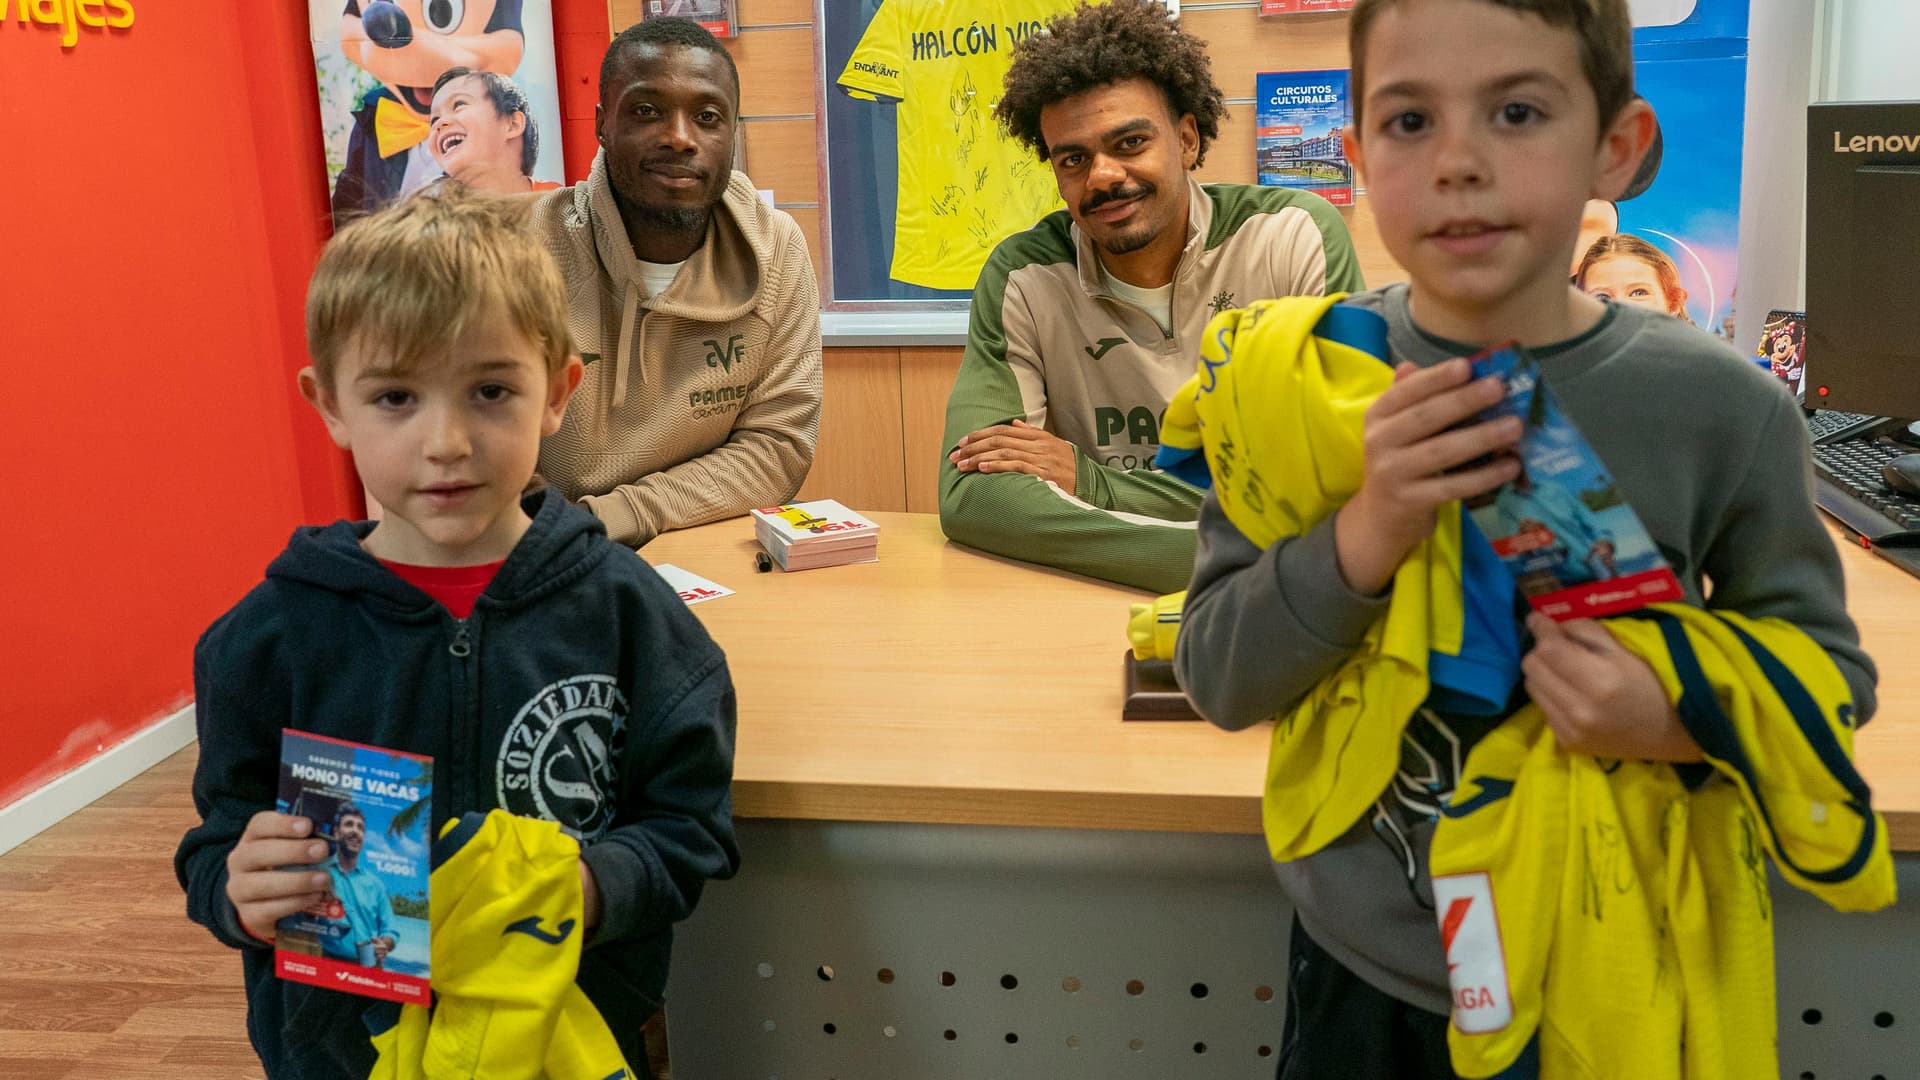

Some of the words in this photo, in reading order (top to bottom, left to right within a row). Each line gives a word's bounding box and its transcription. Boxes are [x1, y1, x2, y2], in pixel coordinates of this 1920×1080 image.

[911, 21, 997, 61] HALCÓN
[1270, 94, 1338, 105] CULTURALES
[1276, 85, 1332, 96] CIRCUITOS
[291, 763, 339, 787] MONO
[341, 773, 363, 791] DE
[366, 778, 420, 802] VACAS
